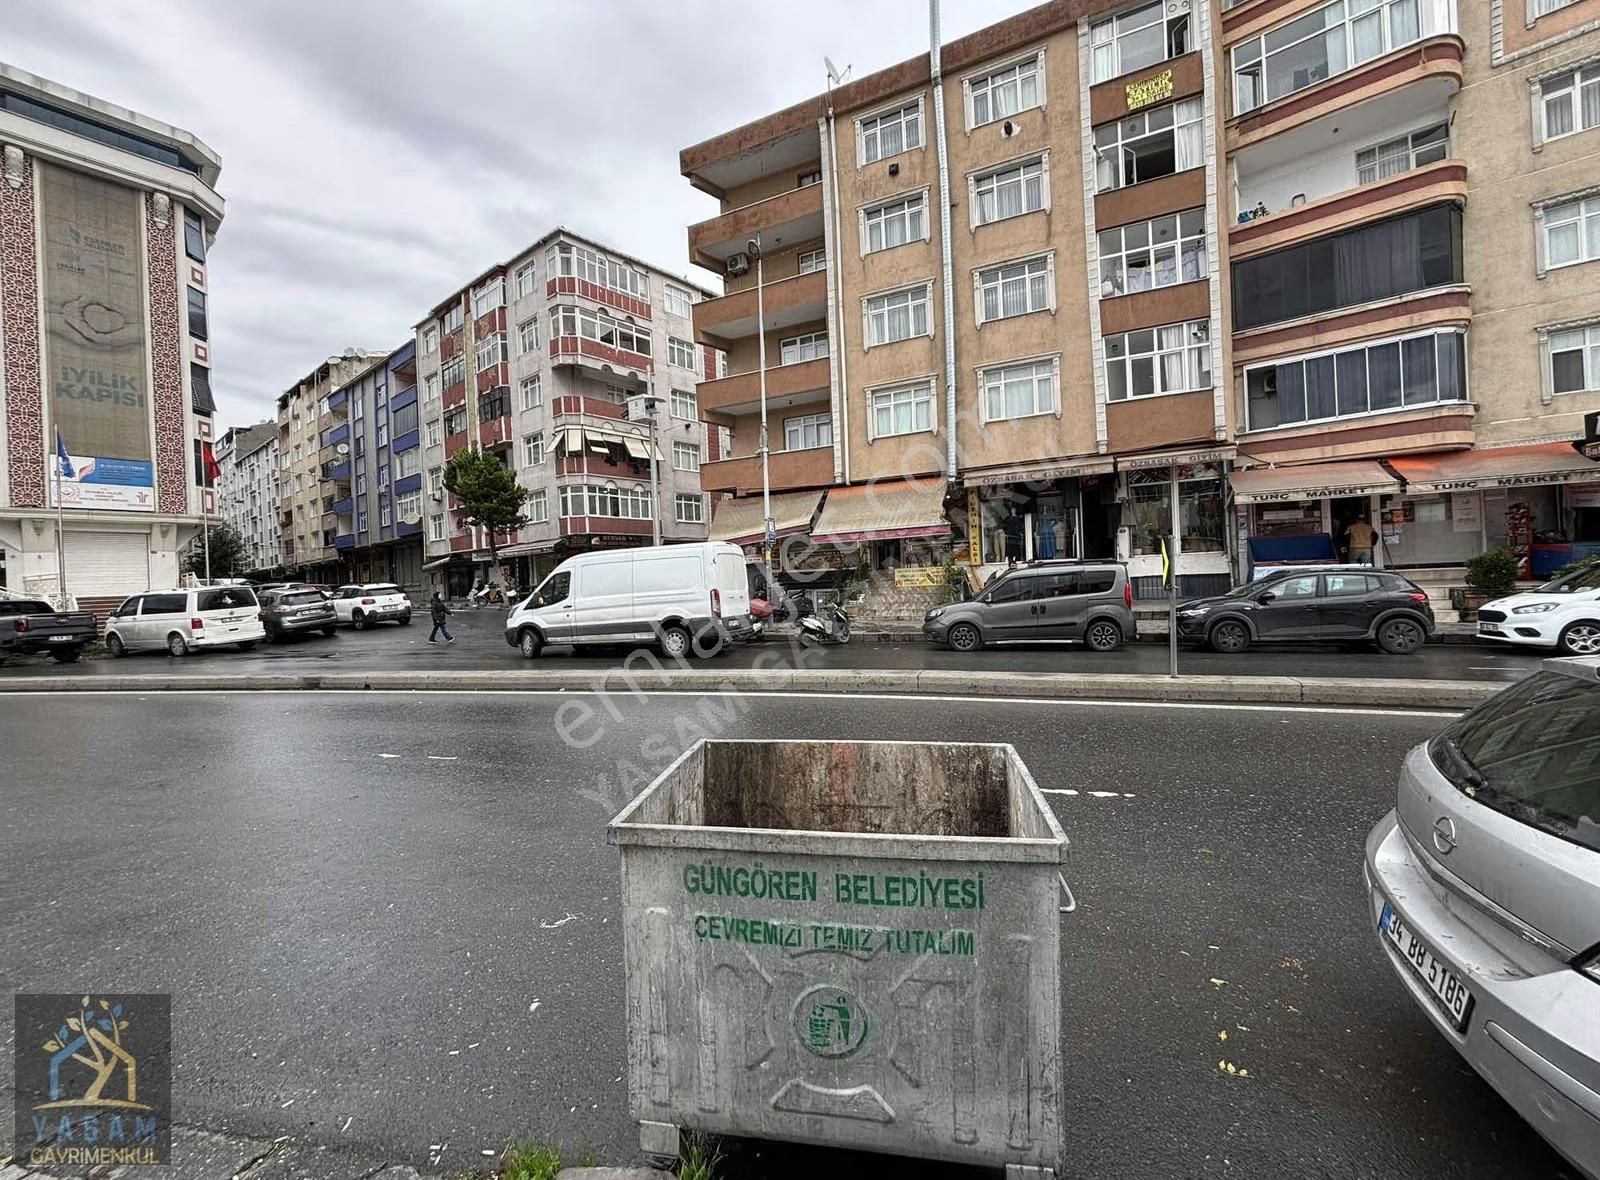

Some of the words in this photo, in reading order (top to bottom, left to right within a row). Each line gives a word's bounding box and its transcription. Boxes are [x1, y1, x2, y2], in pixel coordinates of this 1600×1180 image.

[1252, 493, 1289, 501] TUNÇ
[1305, 487, 1369, 498] MARKET
[1431, 481, 1478, 490] TUNÇ
[1497, 474, 1571, 486] MARKET
[683, 861, 817, 901] GÜNGÖREN
[836, 870, 985, 909] BELEDİYESİ
[885, 929, 975, 956] TUTALIM
[1389, 912, 1402, 942] 34
[1408, 936, 1426, 971] BB
[1428, 958, 1465, 1016] 5186
